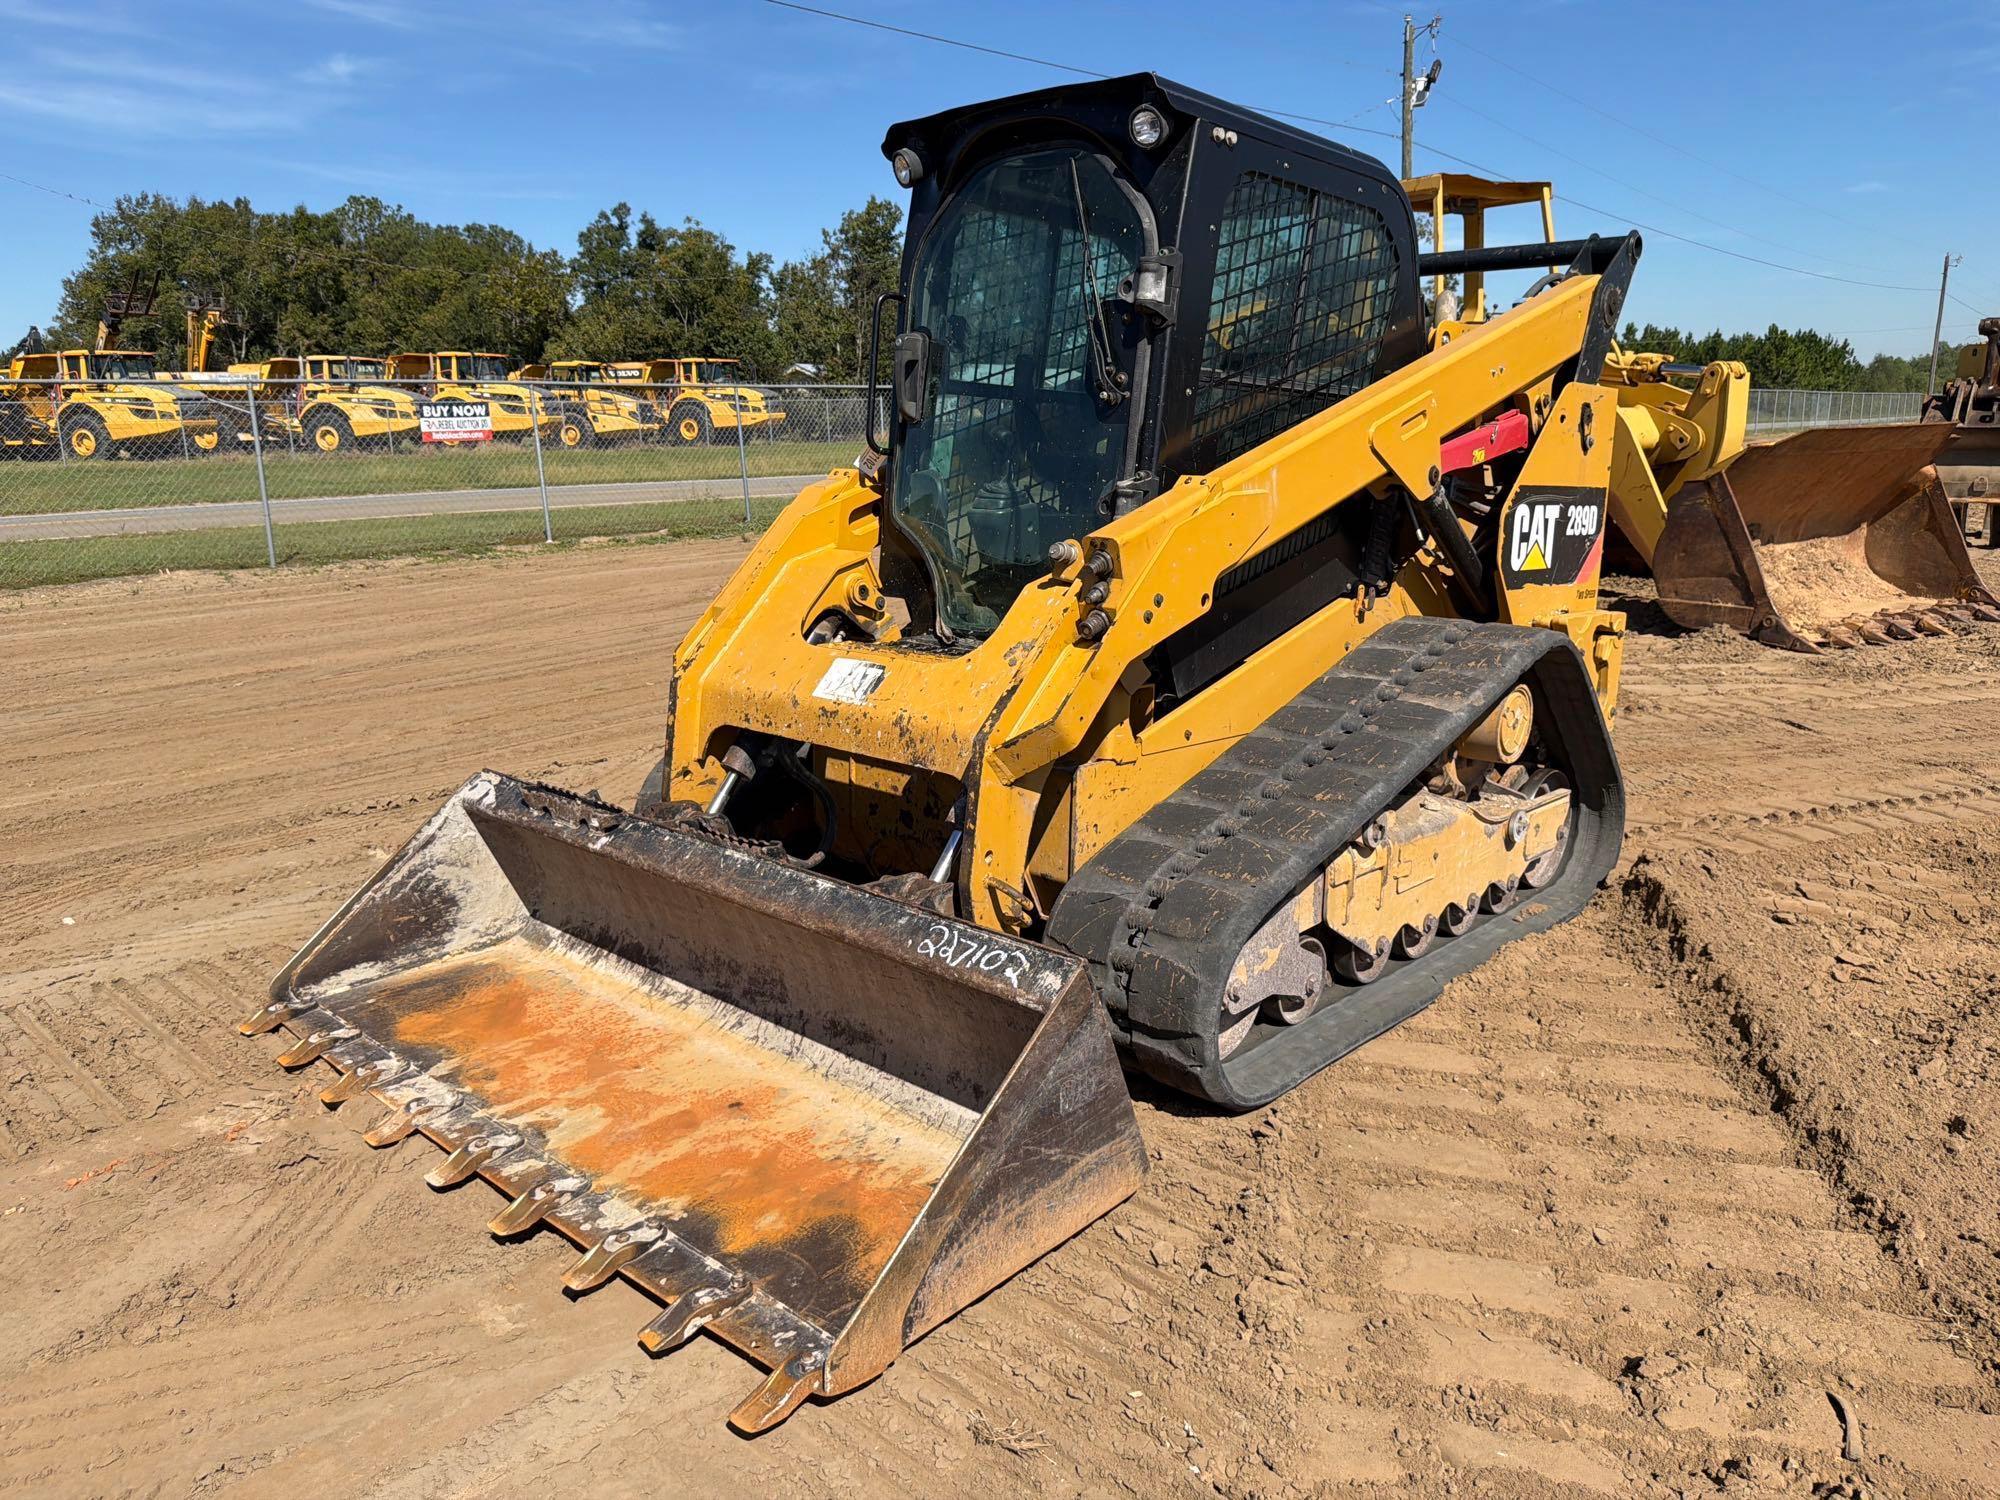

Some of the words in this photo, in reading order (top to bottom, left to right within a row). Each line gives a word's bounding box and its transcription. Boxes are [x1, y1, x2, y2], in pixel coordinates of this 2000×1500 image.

[422, 405, 450, 417] BUY
[452, 404, 486, 417] NOW
[457, 419, 480, 429] AUCTION
[1510, 503, 1561, 572] CAT
[1565, 505, 1598, 536] 289D
